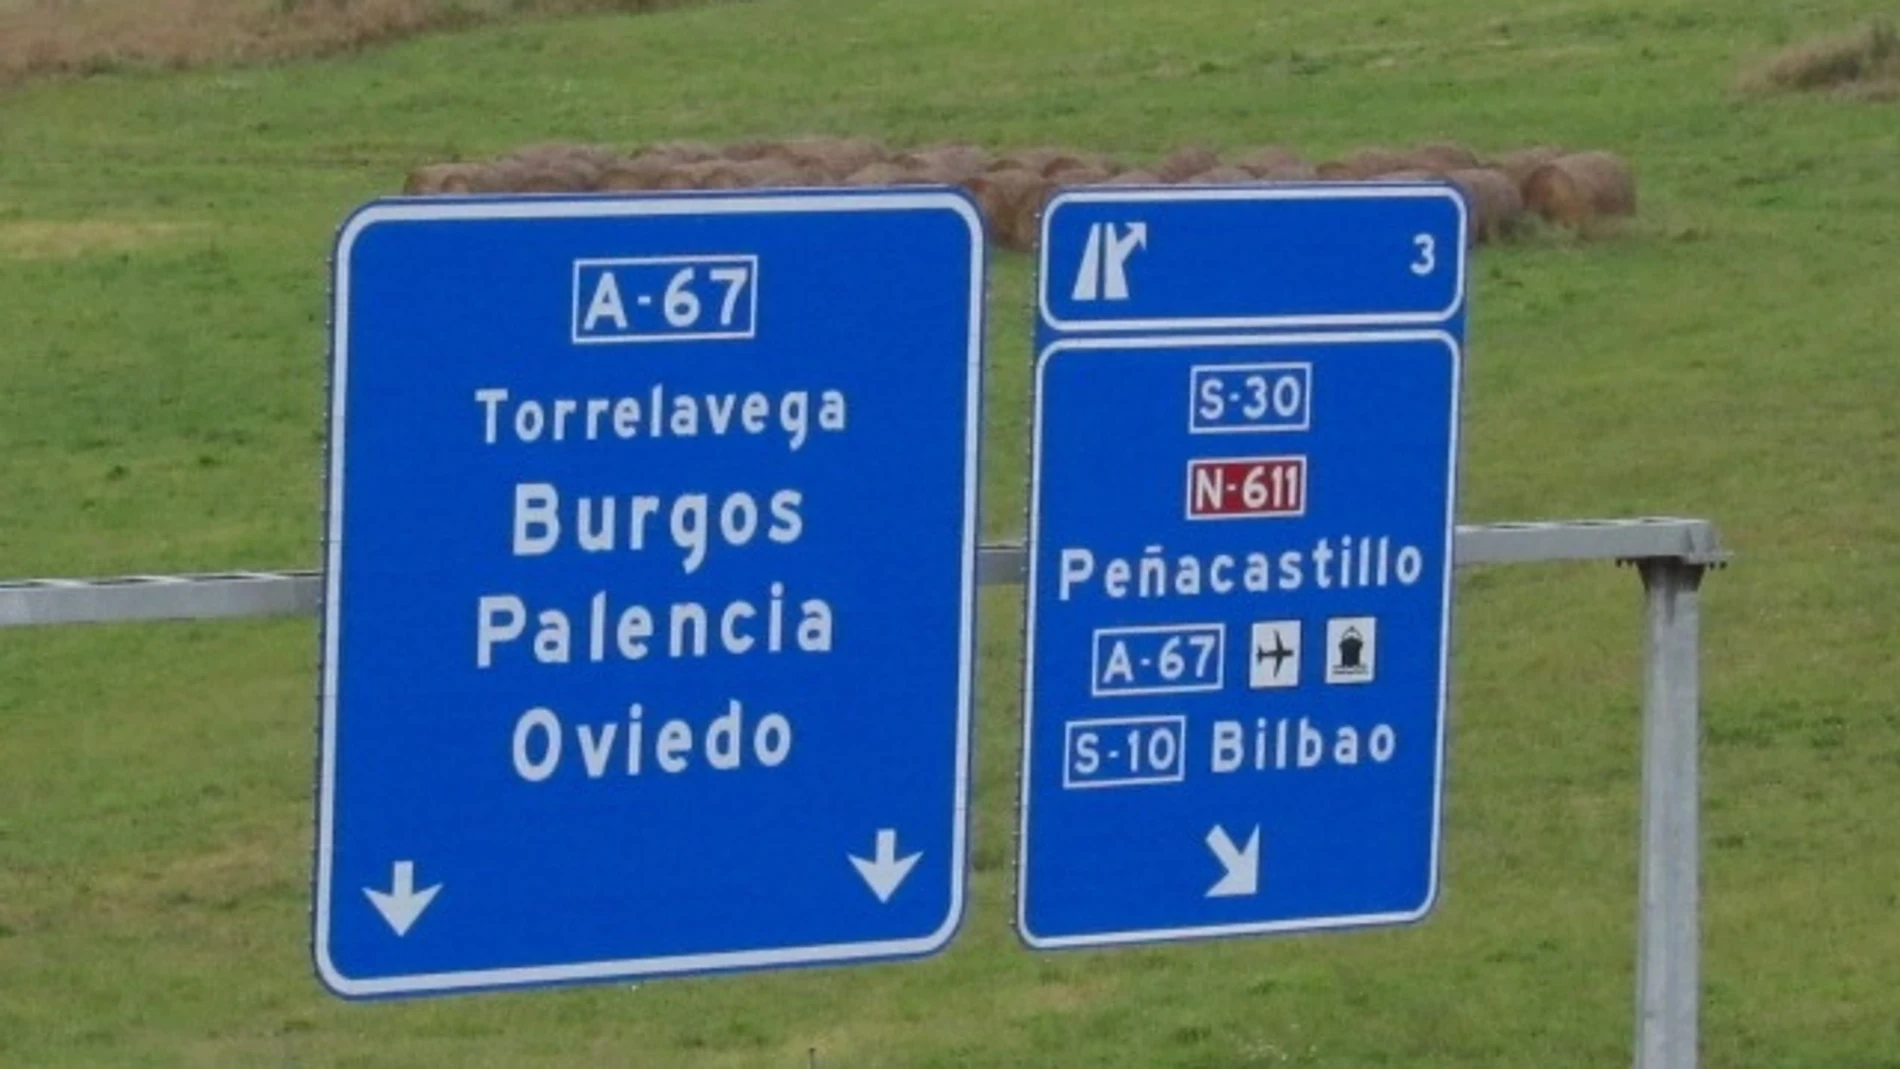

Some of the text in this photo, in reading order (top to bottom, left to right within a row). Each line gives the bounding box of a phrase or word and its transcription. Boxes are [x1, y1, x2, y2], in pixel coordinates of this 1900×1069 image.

[1410, 233, 1436, 276] 3
[582, 268, 750, 331] A-67
[475, 384, 847, 451] Torrelavega
[1199, 376, 1302, 420] S-30
[1195, 464, 1300, 512] N-611
[513, 483, 803, 574] Burgos
[1059, 535, 1422, 600] Peñacastillo
[476, 581, 833, 668] Palencia
[1102, 635, 1217, 684] A-67
[512, 698, 792, 782] Oviedo
[1074, 715, 1396, 775] S-10 Bilbao
